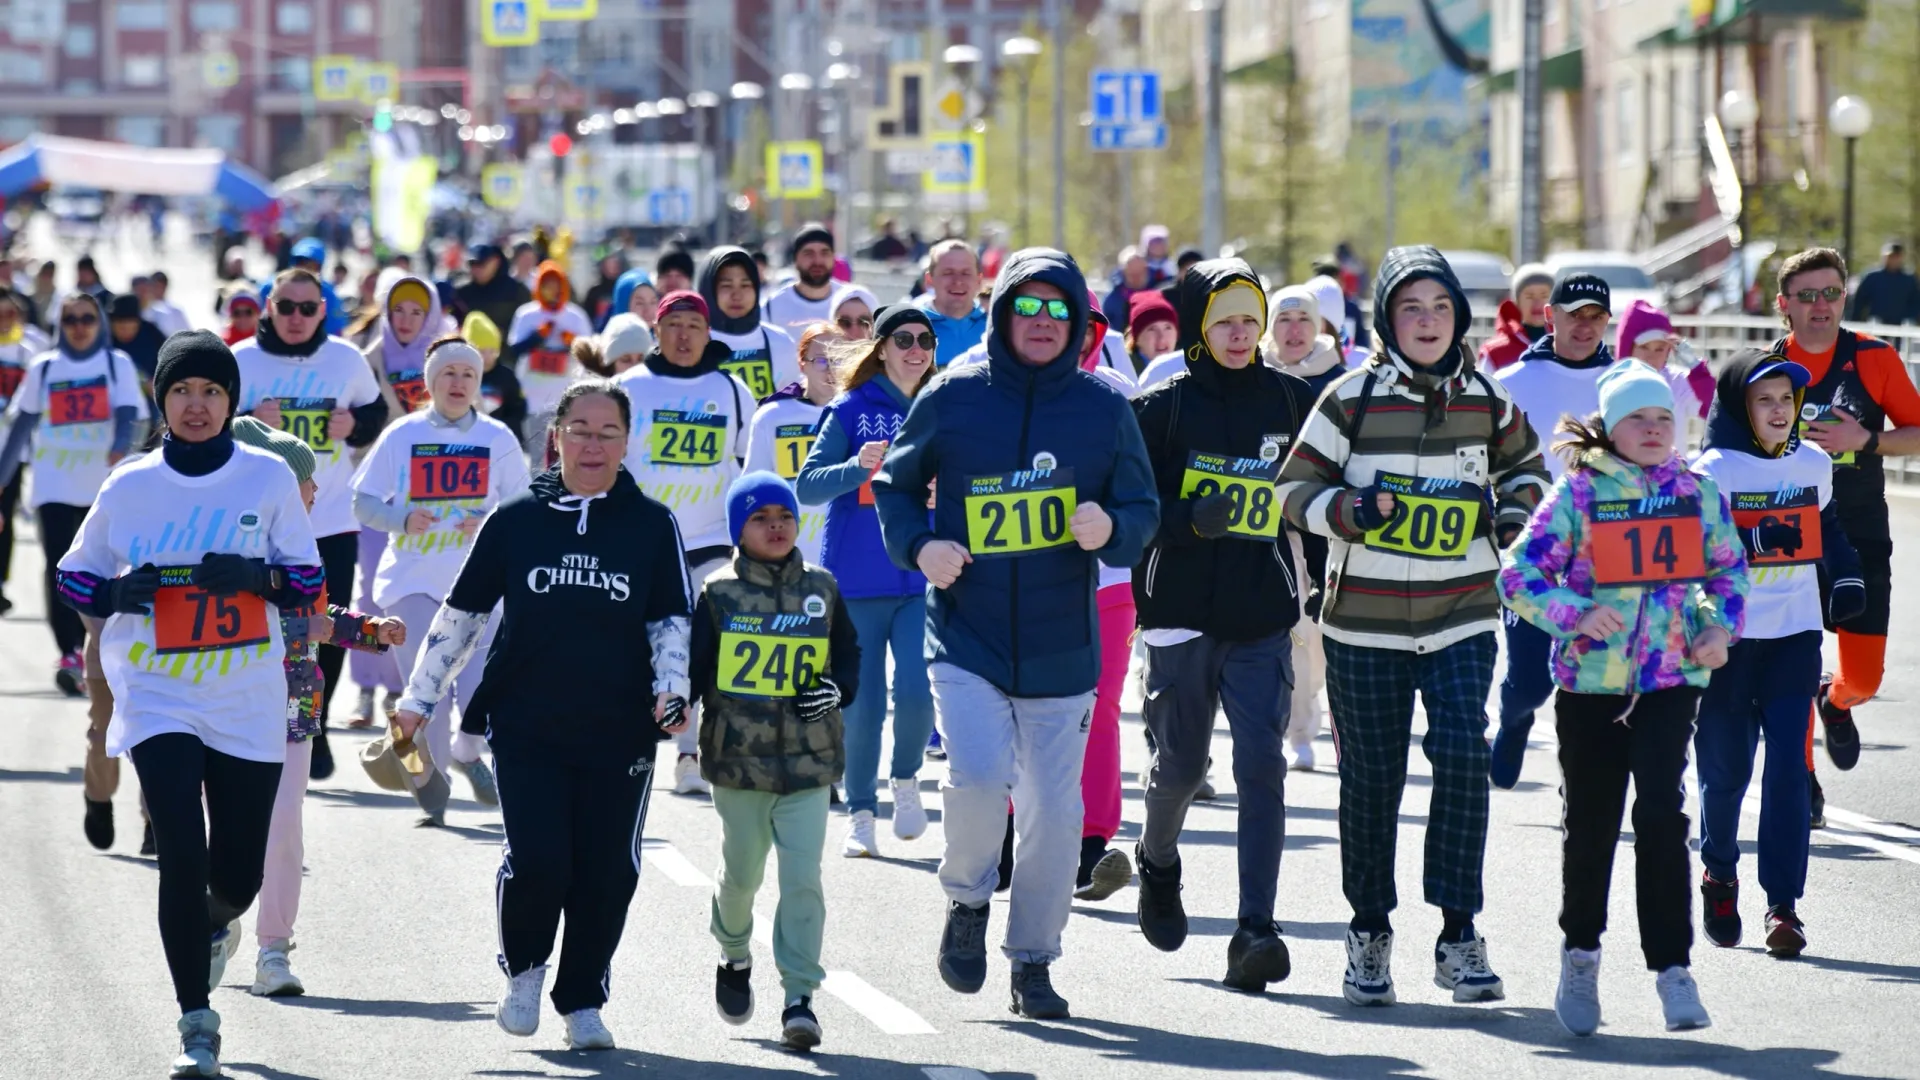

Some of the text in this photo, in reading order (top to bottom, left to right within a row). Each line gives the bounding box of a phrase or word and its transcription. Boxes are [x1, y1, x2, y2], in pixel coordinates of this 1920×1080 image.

[1568, 283, 1607, 295] YAMAL
[720, 365, 768, 397] 15
[660, 427, 718, 460] 244
[421, 461, 481, 493] 104
[971, 485, 1004, 495] ЯМАЛ
[980, 496, 1066, 548] 210
[1379, 500, 1465, 552] 209
[561, 554, 600, 570] STYLE
[1624, 525, 1678, 576] 14
[527, 567, 630, 602] CHILLYS
[185, 592, 241, 642] 75
[729, 623, 763, 634] ЯМАЛ
[1506, 609, 1520, 628] 89
[731, 640, 817, 692] 246
